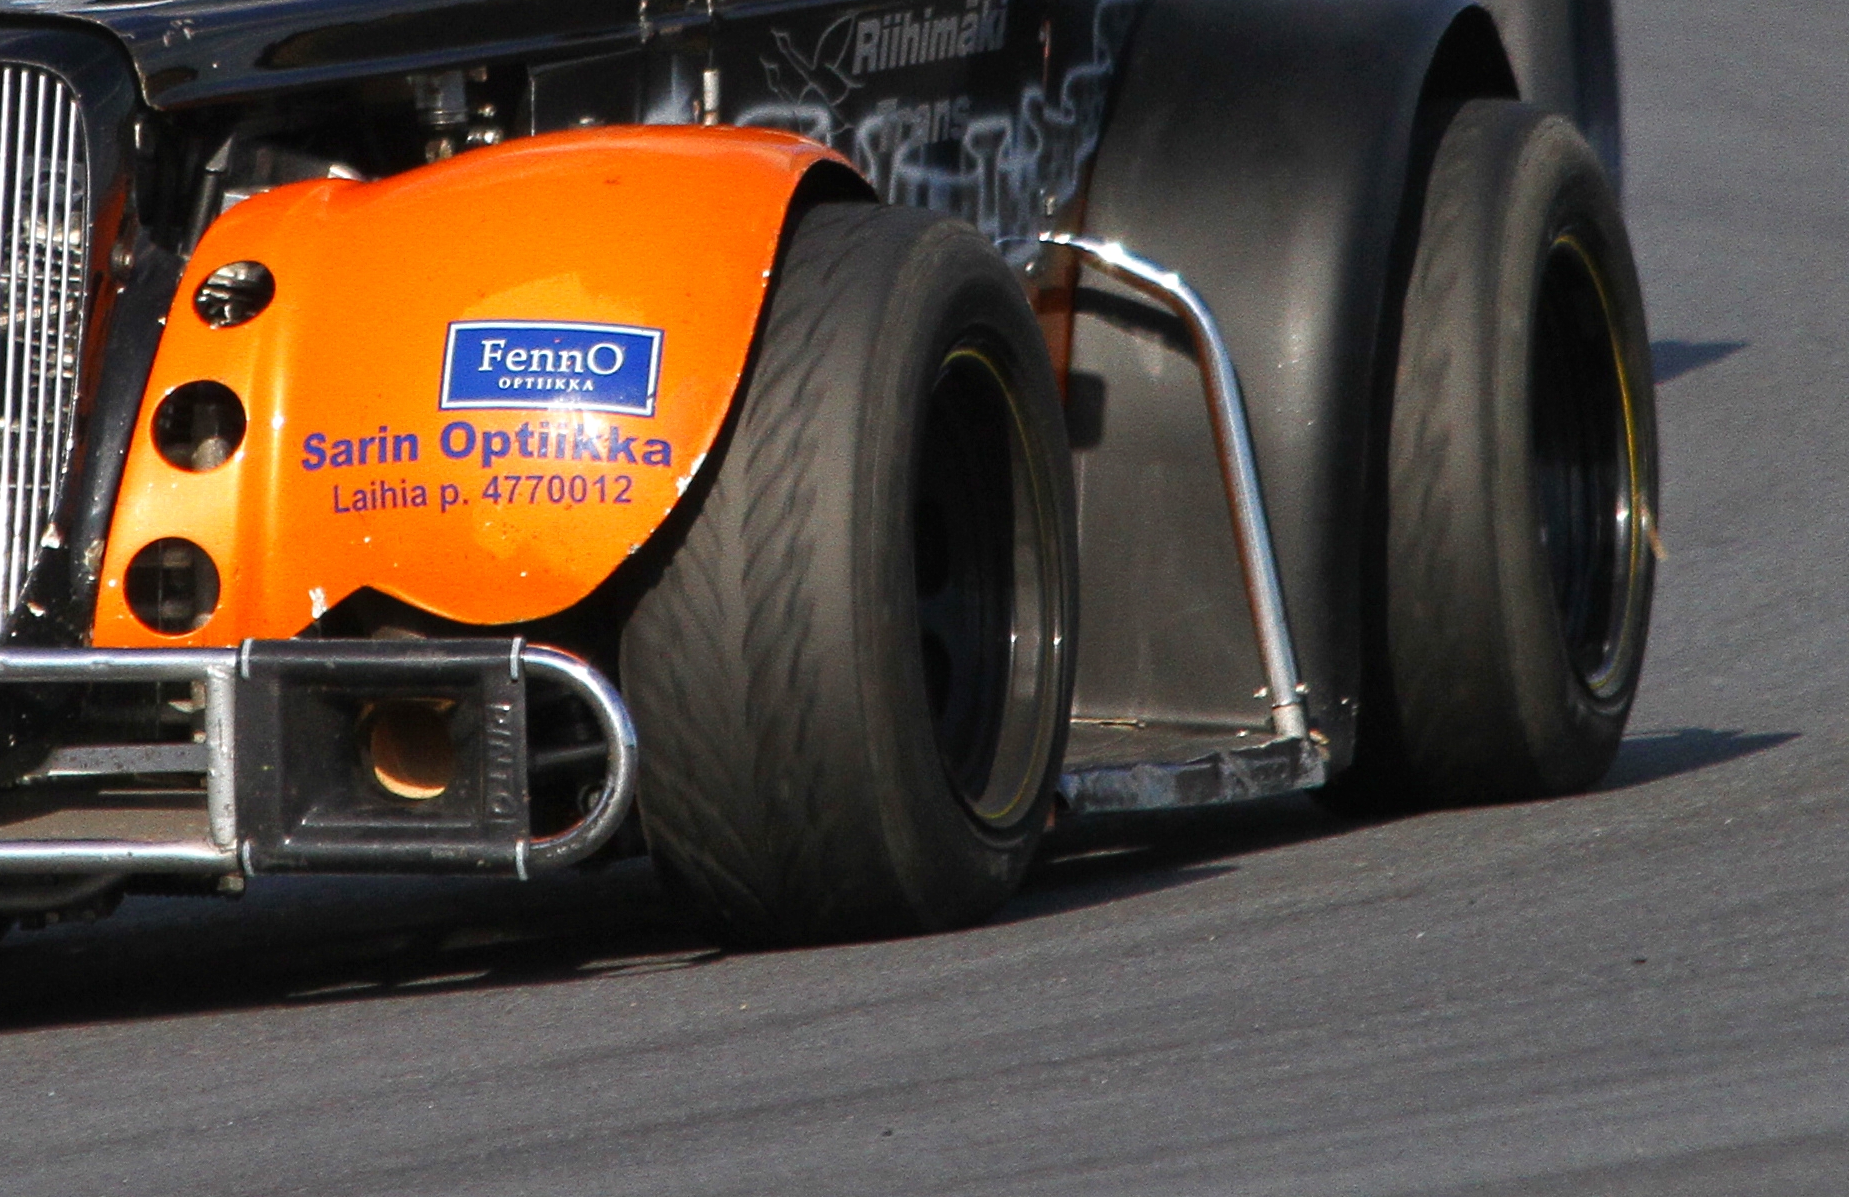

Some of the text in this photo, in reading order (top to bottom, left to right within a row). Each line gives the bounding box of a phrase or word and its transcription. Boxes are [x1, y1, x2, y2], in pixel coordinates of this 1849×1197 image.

[478, 339, 624, 375] FennO
[498, 376, 594, 391] OPTIIKKA
[301, 421, 671, 471] Sarin Optiikka
[332, 475, 633, 514] Laihia p. 4770012
